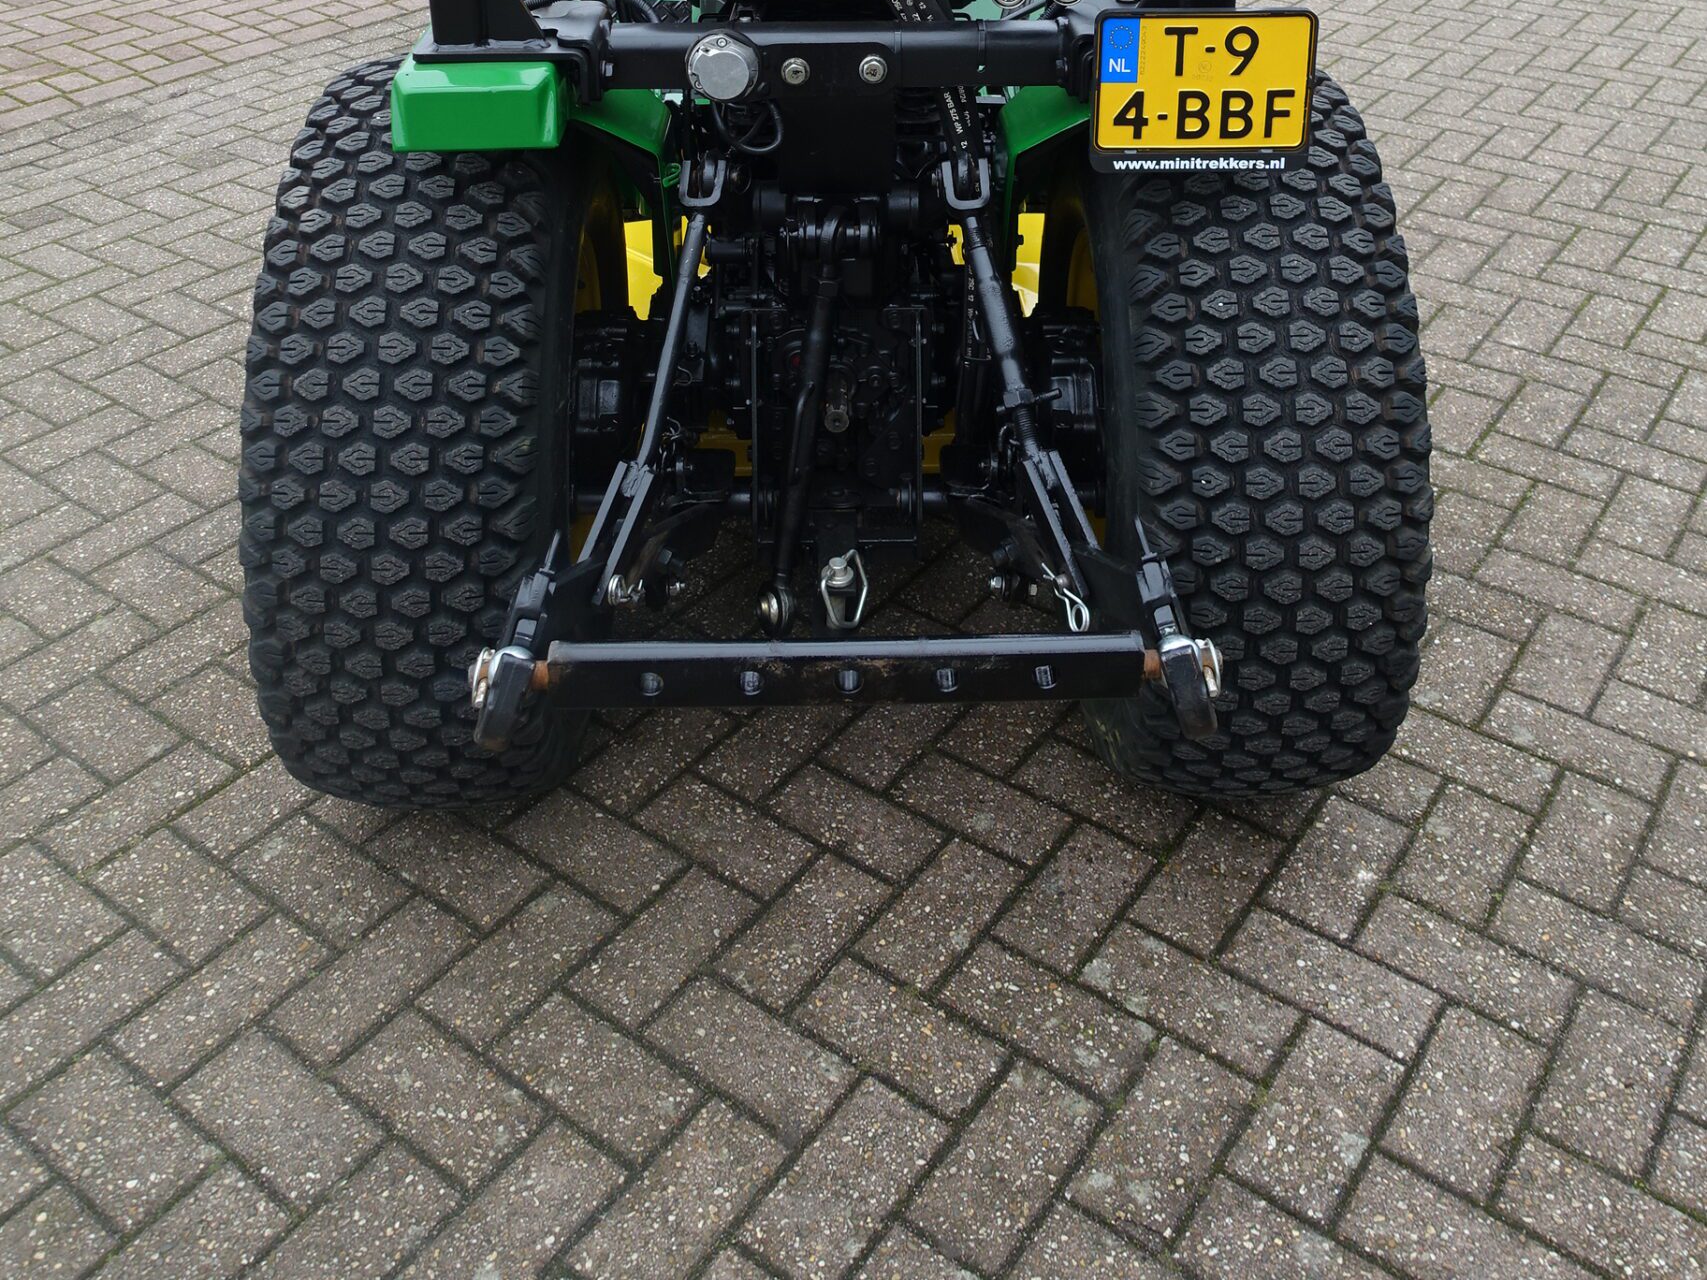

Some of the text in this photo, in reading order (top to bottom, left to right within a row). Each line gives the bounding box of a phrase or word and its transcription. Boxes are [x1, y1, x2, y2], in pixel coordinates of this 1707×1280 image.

[1164, 25, 1260, 77] T-9
[1108, 58, 1131, 73] NL
[943, 91, 955, 109] BAR
[1113, 88, 1296, 140] 4-BBF
[953, 122, 964, 134] WP
[1113, 157, 1286, 171] www.minitrekkers.nl
